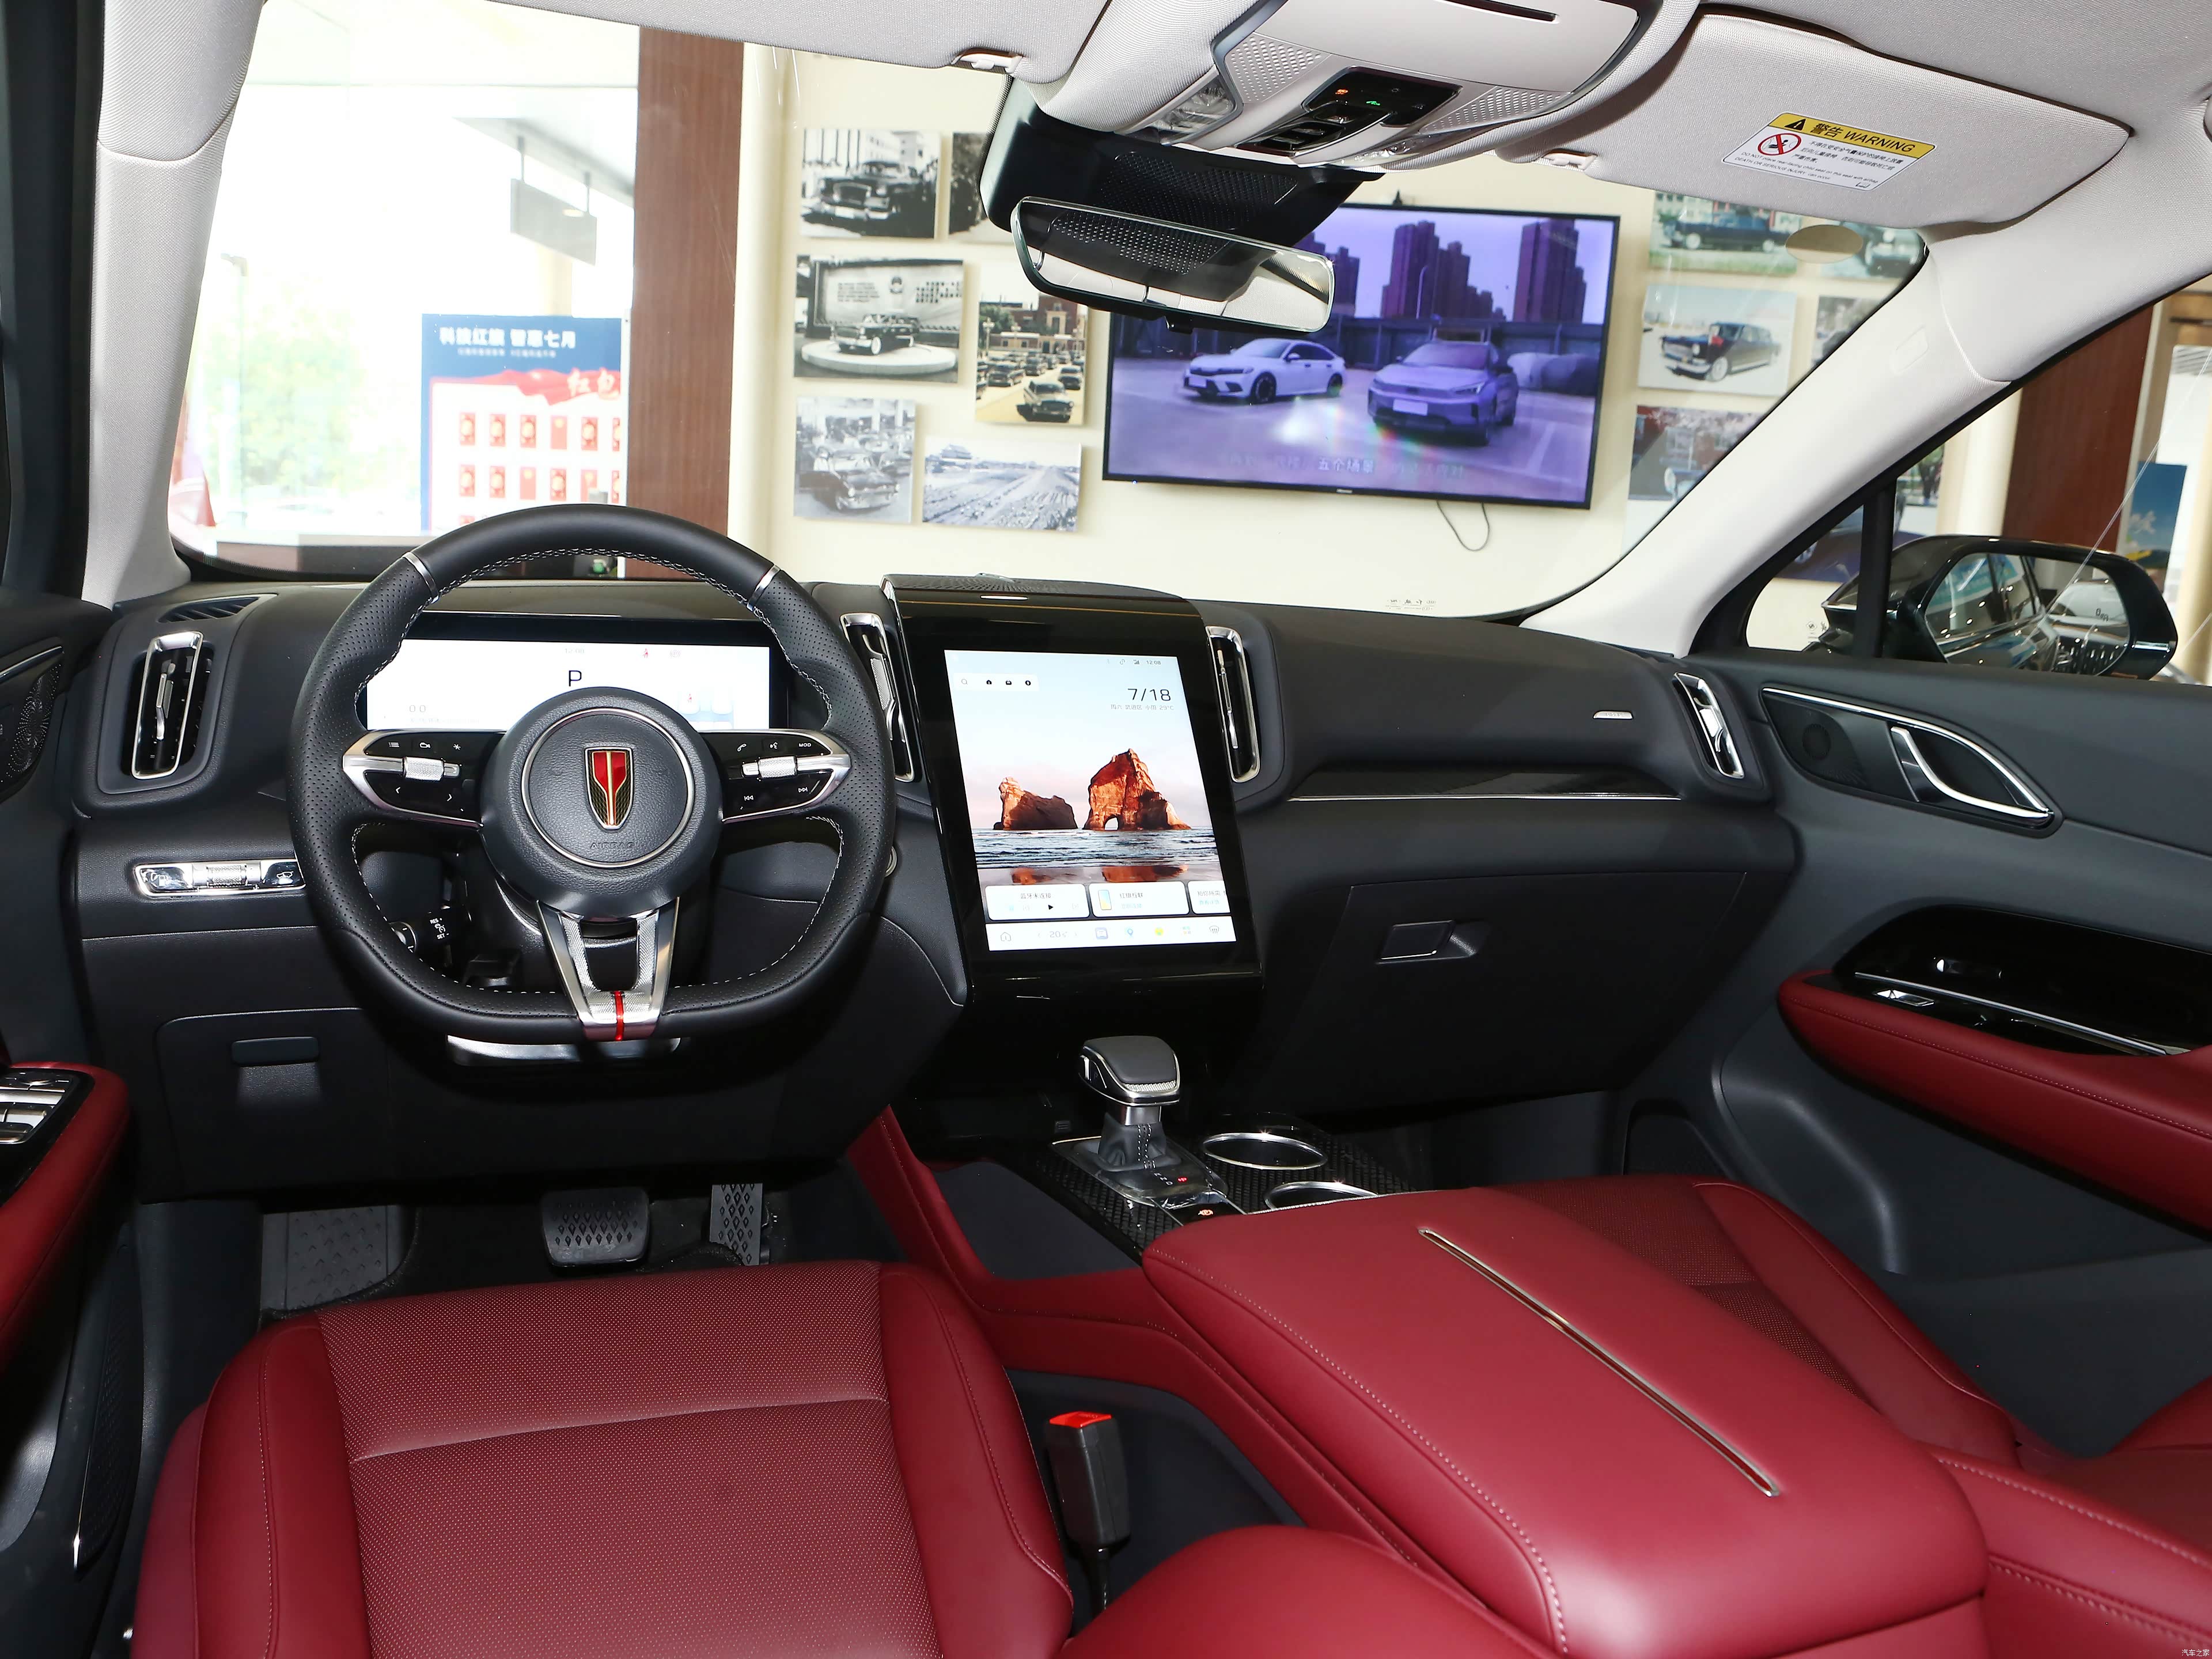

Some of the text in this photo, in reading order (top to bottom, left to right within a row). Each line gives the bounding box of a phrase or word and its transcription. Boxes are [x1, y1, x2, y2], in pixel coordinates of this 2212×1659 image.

[1810, 123, 1915, 152] 警告 WARNING
[1763, 162, 1786, 171] SERIOUS
[569, 670, 582, 687] P
[1127, 688, 1171, 702] 7/18
